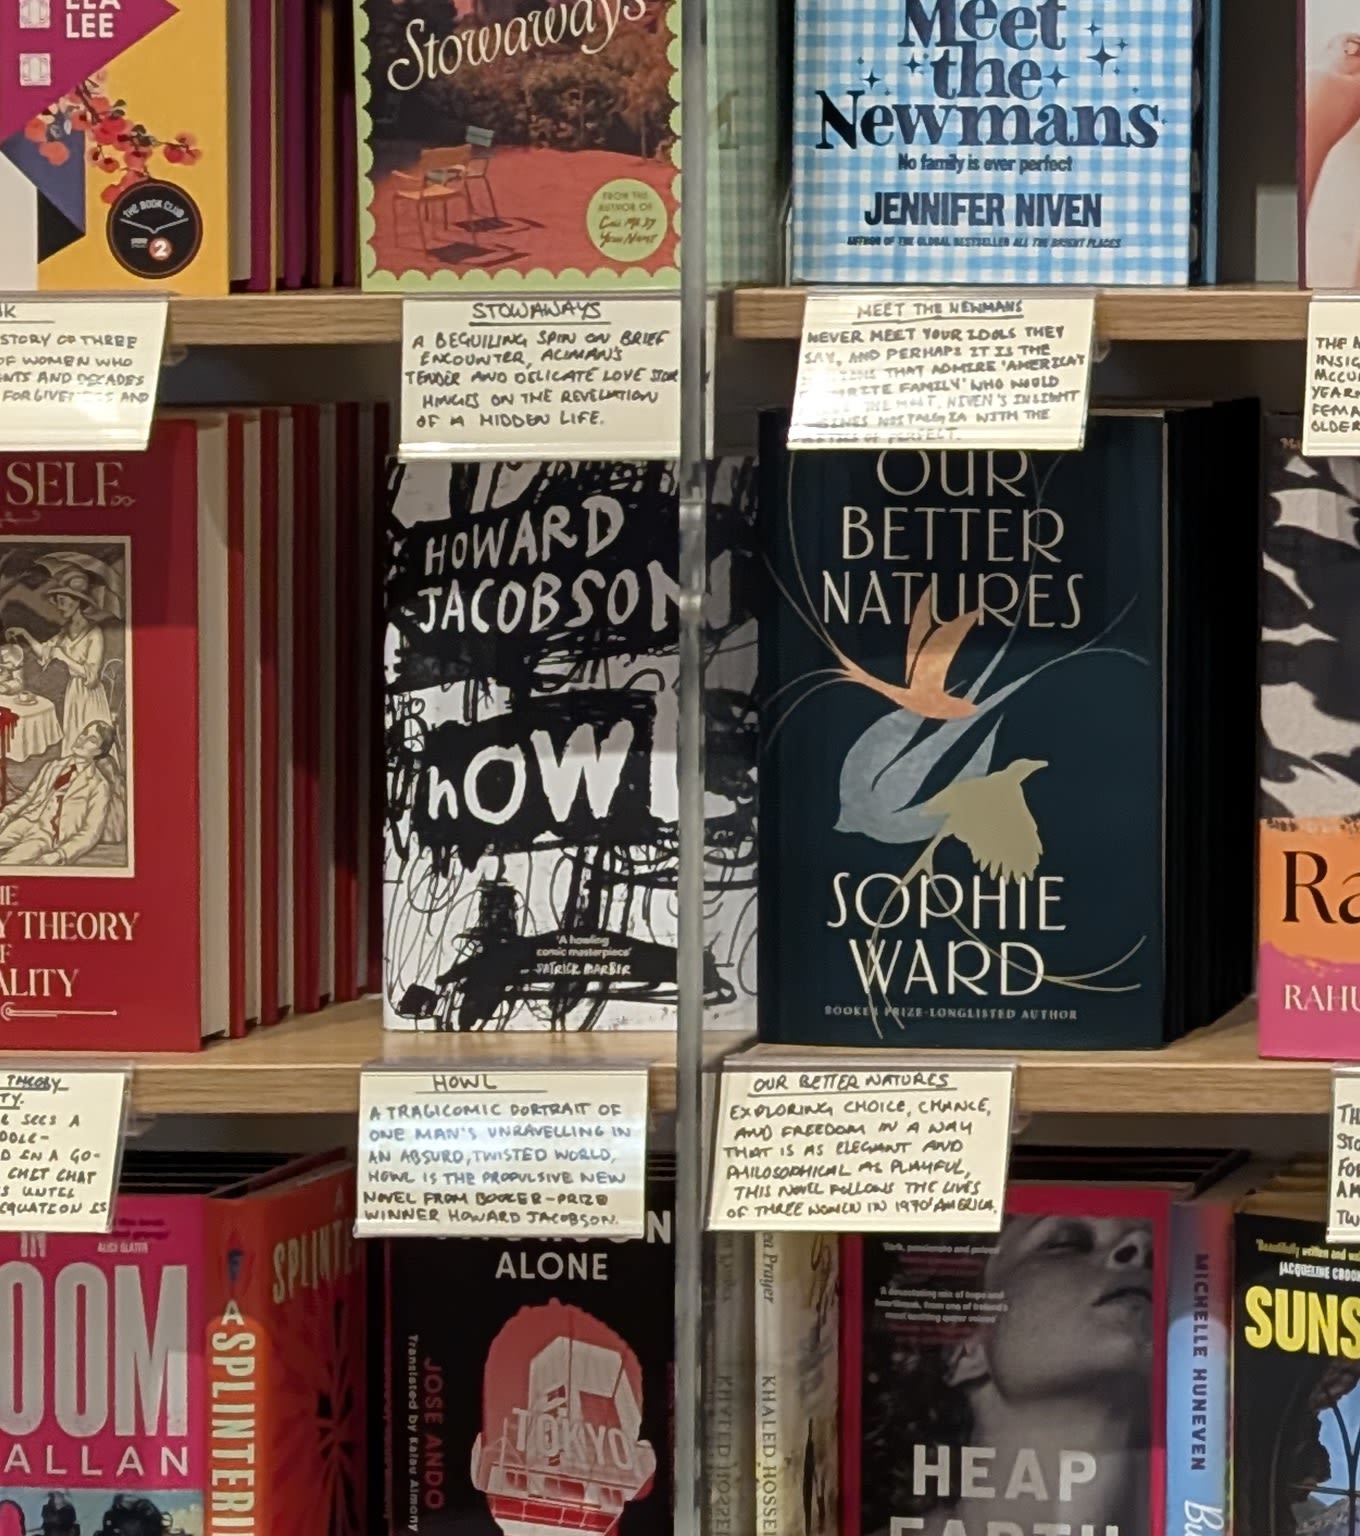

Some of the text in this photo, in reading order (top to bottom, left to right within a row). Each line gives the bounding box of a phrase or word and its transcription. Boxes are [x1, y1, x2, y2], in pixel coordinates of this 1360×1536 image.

[65, 13, 114, 39] LEE
[930, 40, 1044, 101] the
[815, 89, 1160, 150] Newmans
[471, 303, 602, 320] STOWAWAYS
[1316, 337, 1347, 350] THE
[424, 496, 624, 576] HOWARD
[843, 507, 1064, 563] BETTER
[823, 570, 1084, 628] NATURES
[827, 873, 1066, 931] SOPHIE
[849, 940, 1045, 996] WARD
[433, 1074, 497, 1091] HOWL
[495, 1252, 609, 1281] ALONE
[912, 1444, 1097, 1502] HEAP
